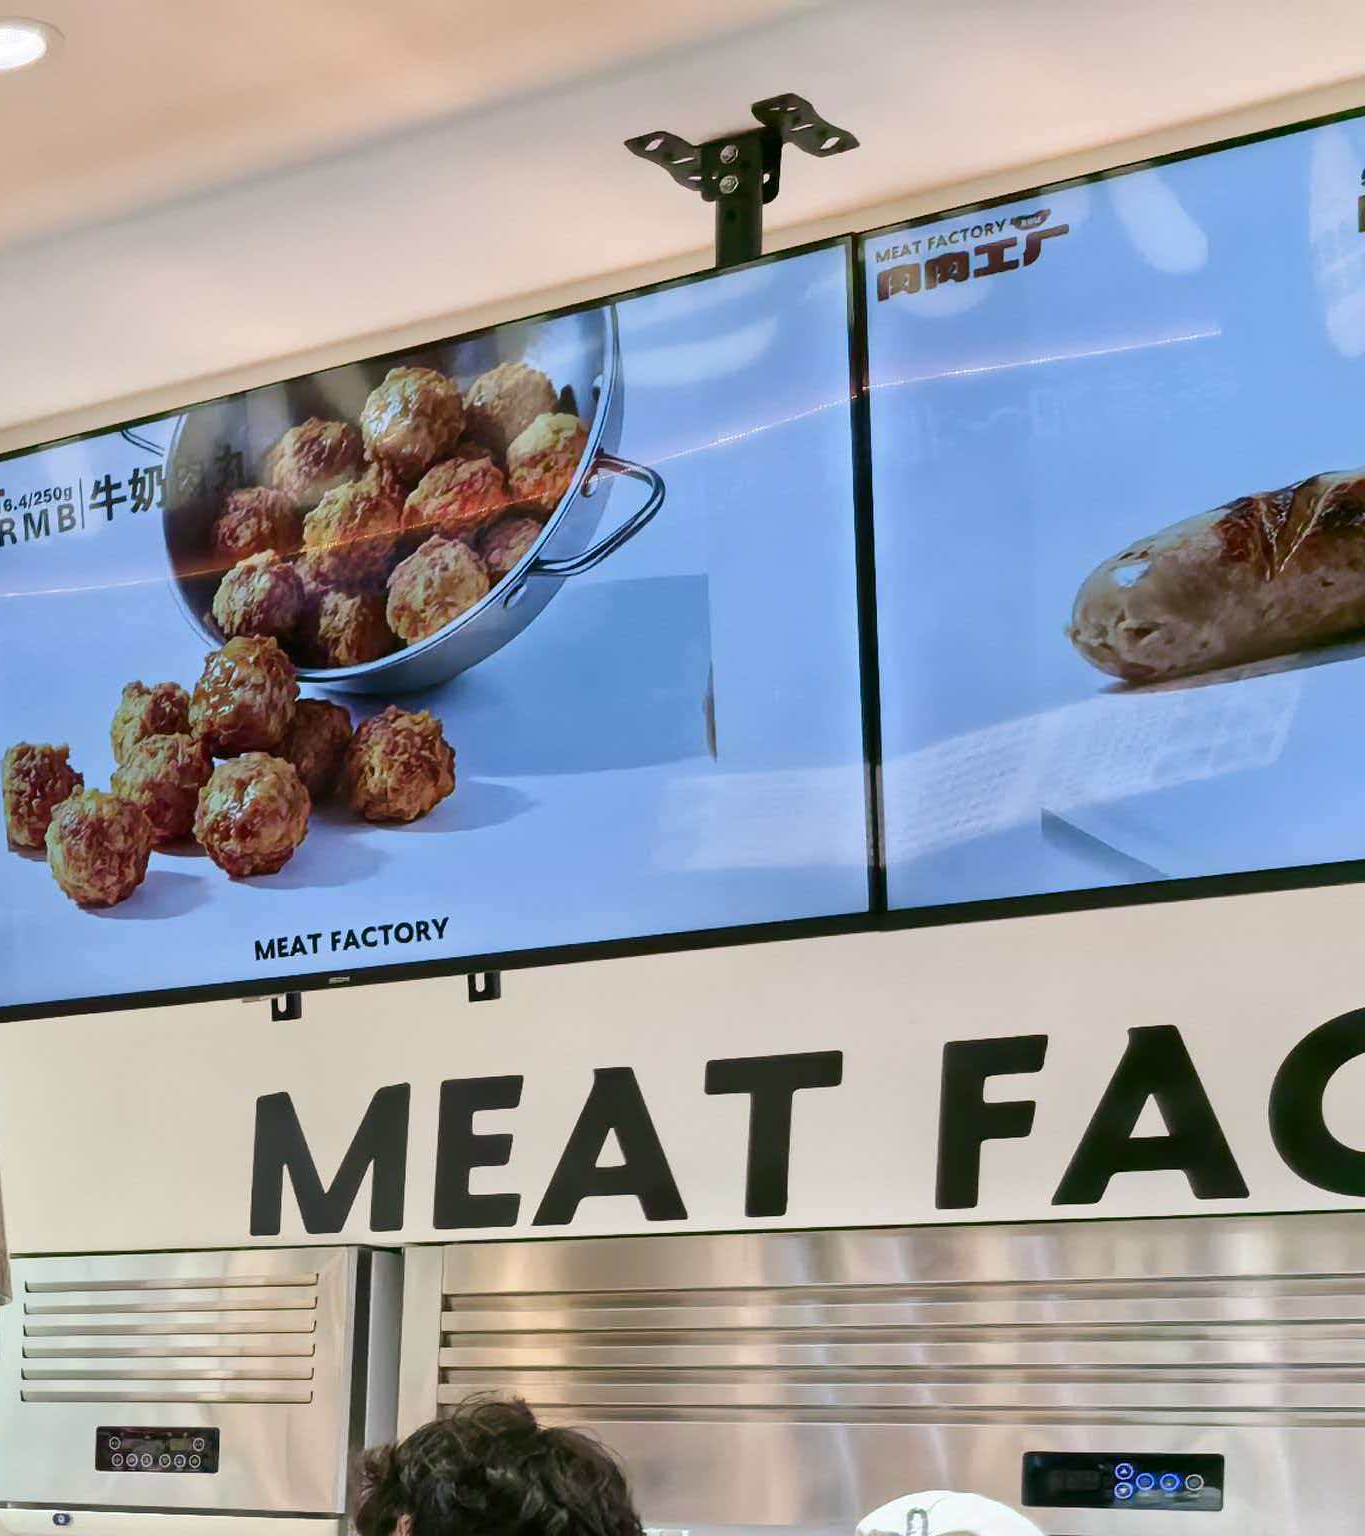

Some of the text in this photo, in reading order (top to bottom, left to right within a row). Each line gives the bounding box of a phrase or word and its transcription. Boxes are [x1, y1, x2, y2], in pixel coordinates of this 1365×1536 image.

[875, 240, 921, 263] MEAT
[927, 218, 1006, 250] FACTORY
[877, 223, 1070, 301] 肉肉工厂
[254, 917, 450, 961] MEAT FACTORY
[249, 1006, 1365, 1237] MEAT FAC
